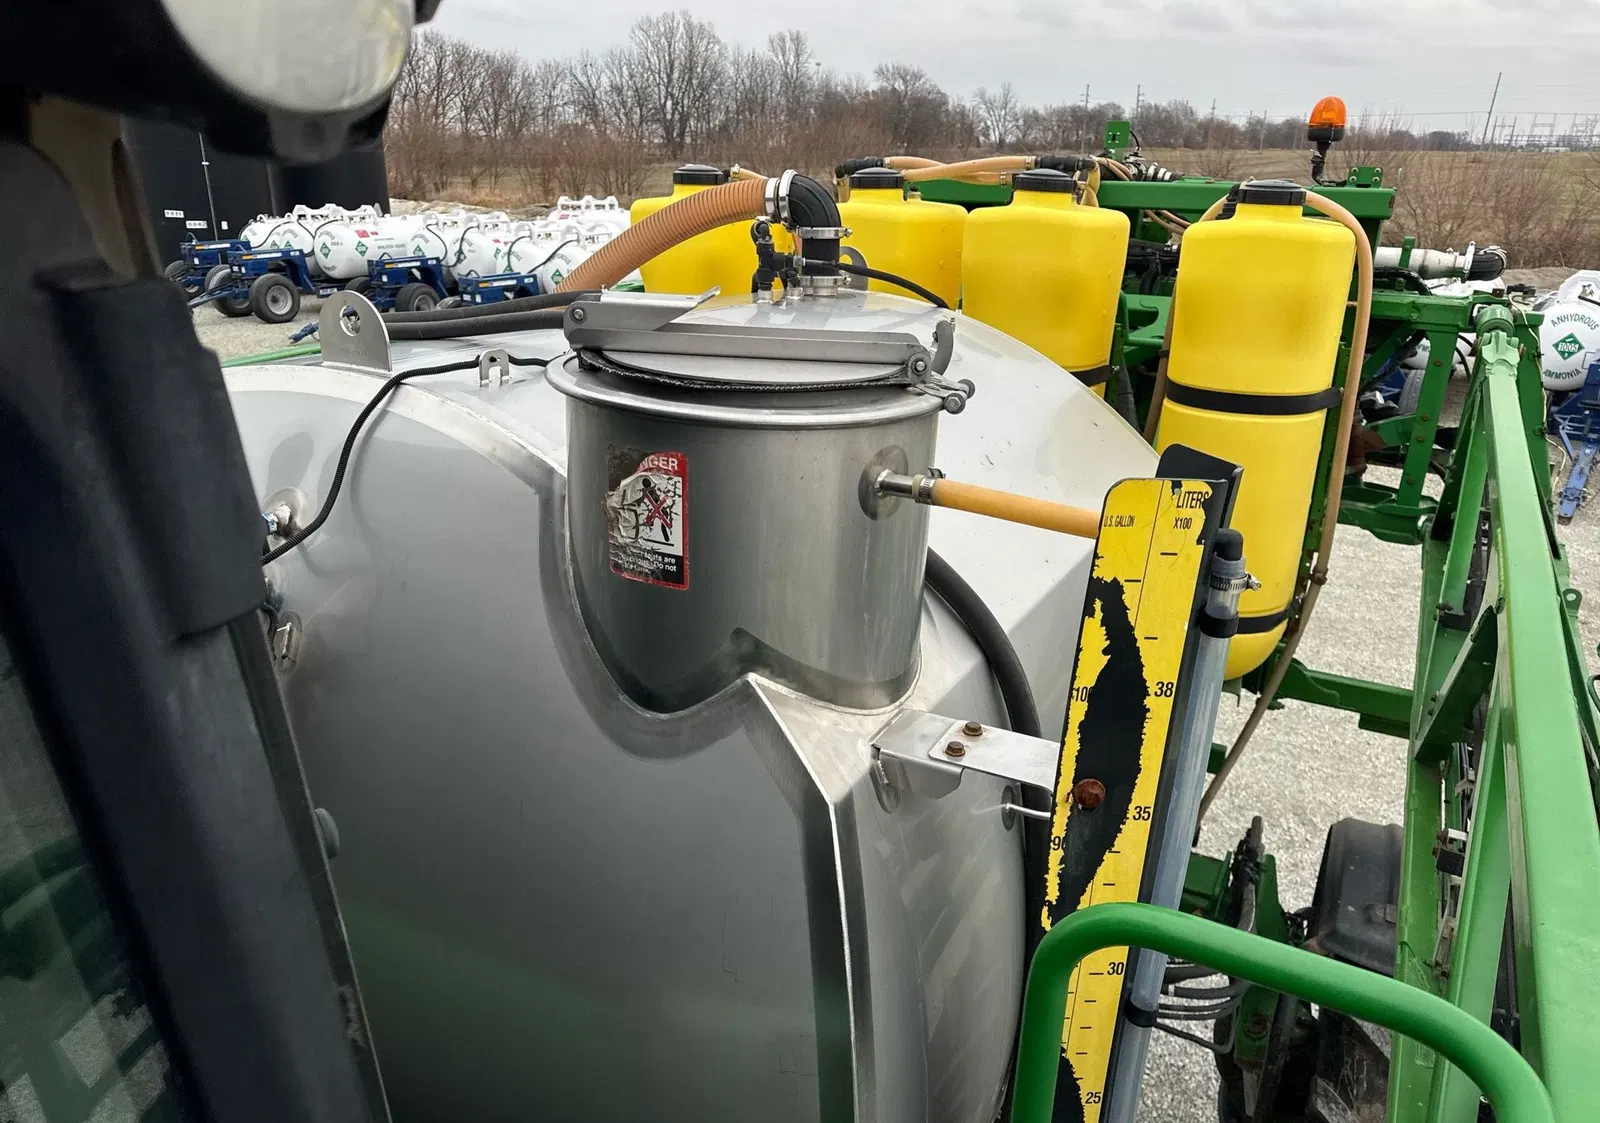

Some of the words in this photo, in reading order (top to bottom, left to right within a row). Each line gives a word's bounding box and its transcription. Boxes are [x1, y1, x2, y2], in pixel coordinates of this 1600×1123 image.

[1551, 313, 1599, 331] ANHYDROUS
[1543, 368, 1582, 380] AMMONIA
[639, 455, 678, 471] NGER
[1114, 514, 1135, 528] GALLON
[1173, 517, 1193, 530] X100
[653, 560, 664, 569] Do
[665, 564, 677, 572] not
[664, 557, 676, 565] are
[1154, 681, 1174, 698] 38
[1132, 805, 1151, 821] 35
[1107, 962, 1124, 976] 30
[1085, 1091, 1101, 1104] 25
